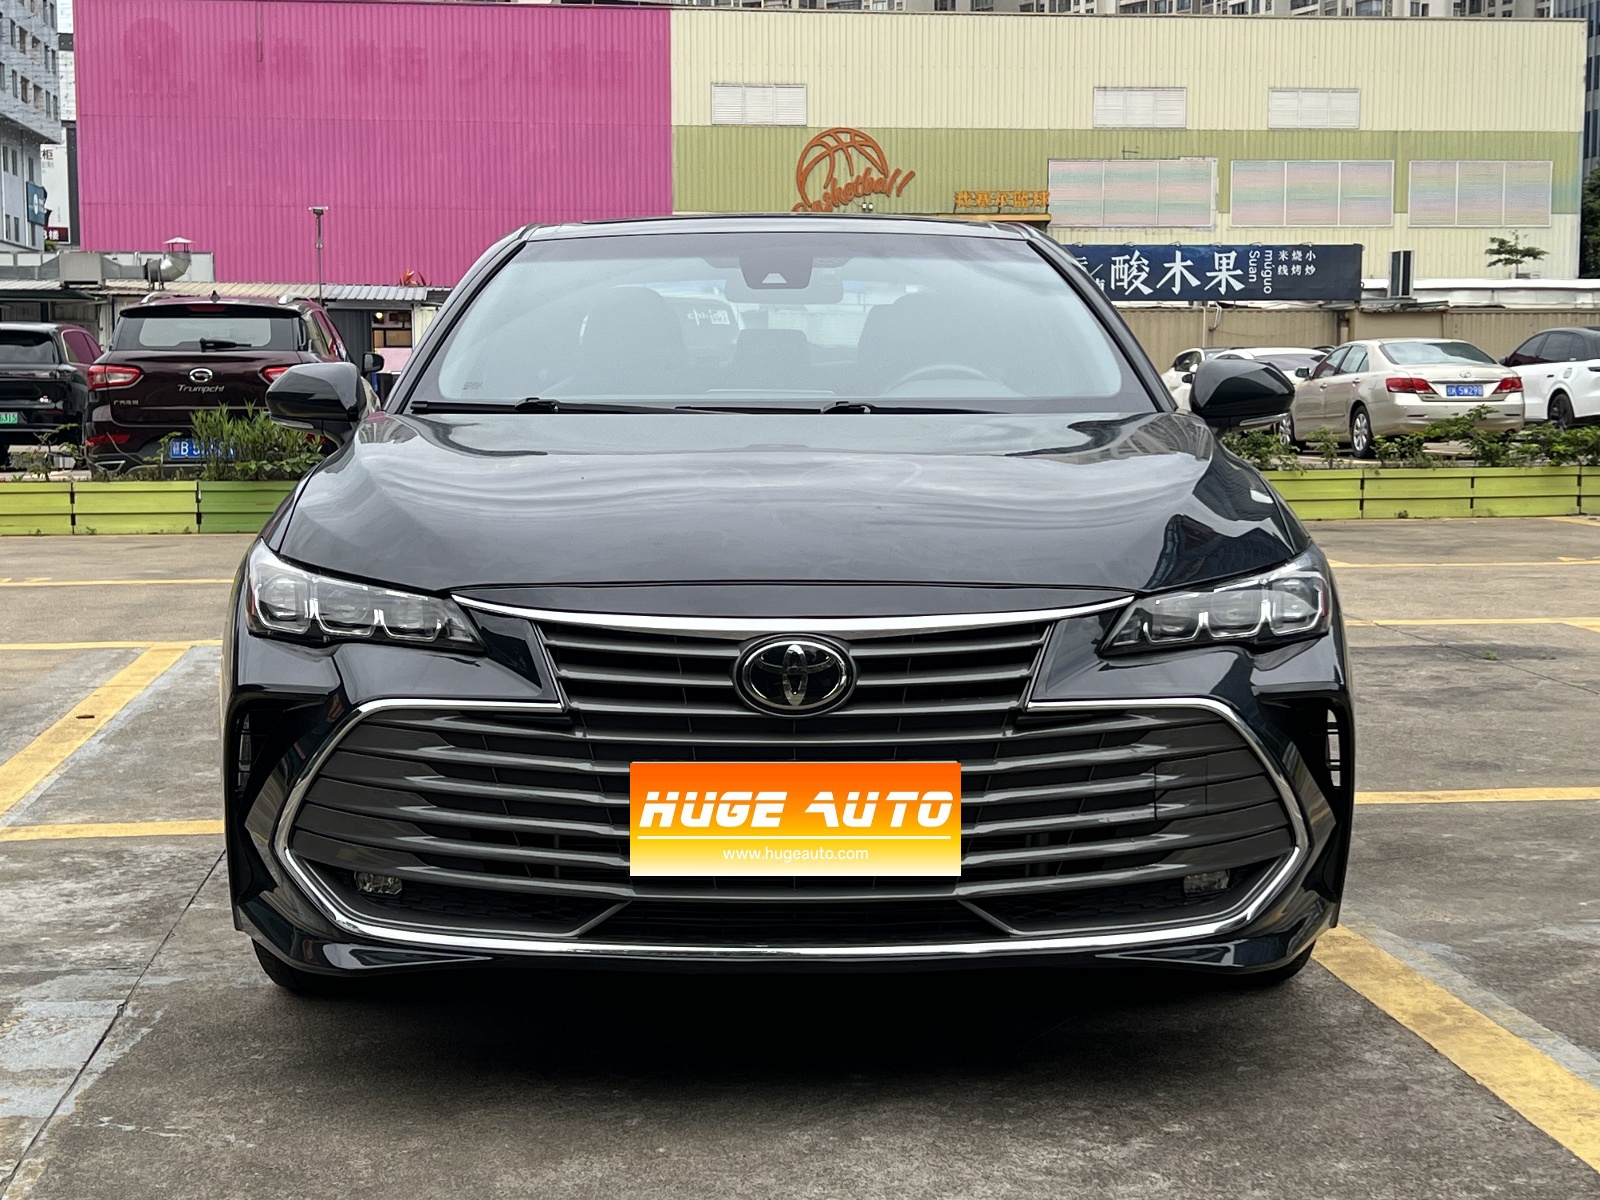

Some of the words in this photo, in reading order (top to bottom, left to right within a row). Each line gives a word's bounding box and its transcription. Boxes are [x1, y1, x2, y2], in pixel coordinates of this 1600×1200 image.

[1110, 249, 1246, 296] 酸木果
[1248, 250, 1260, 283] Suan
[177, 384, 225, 393] Trumpchi
